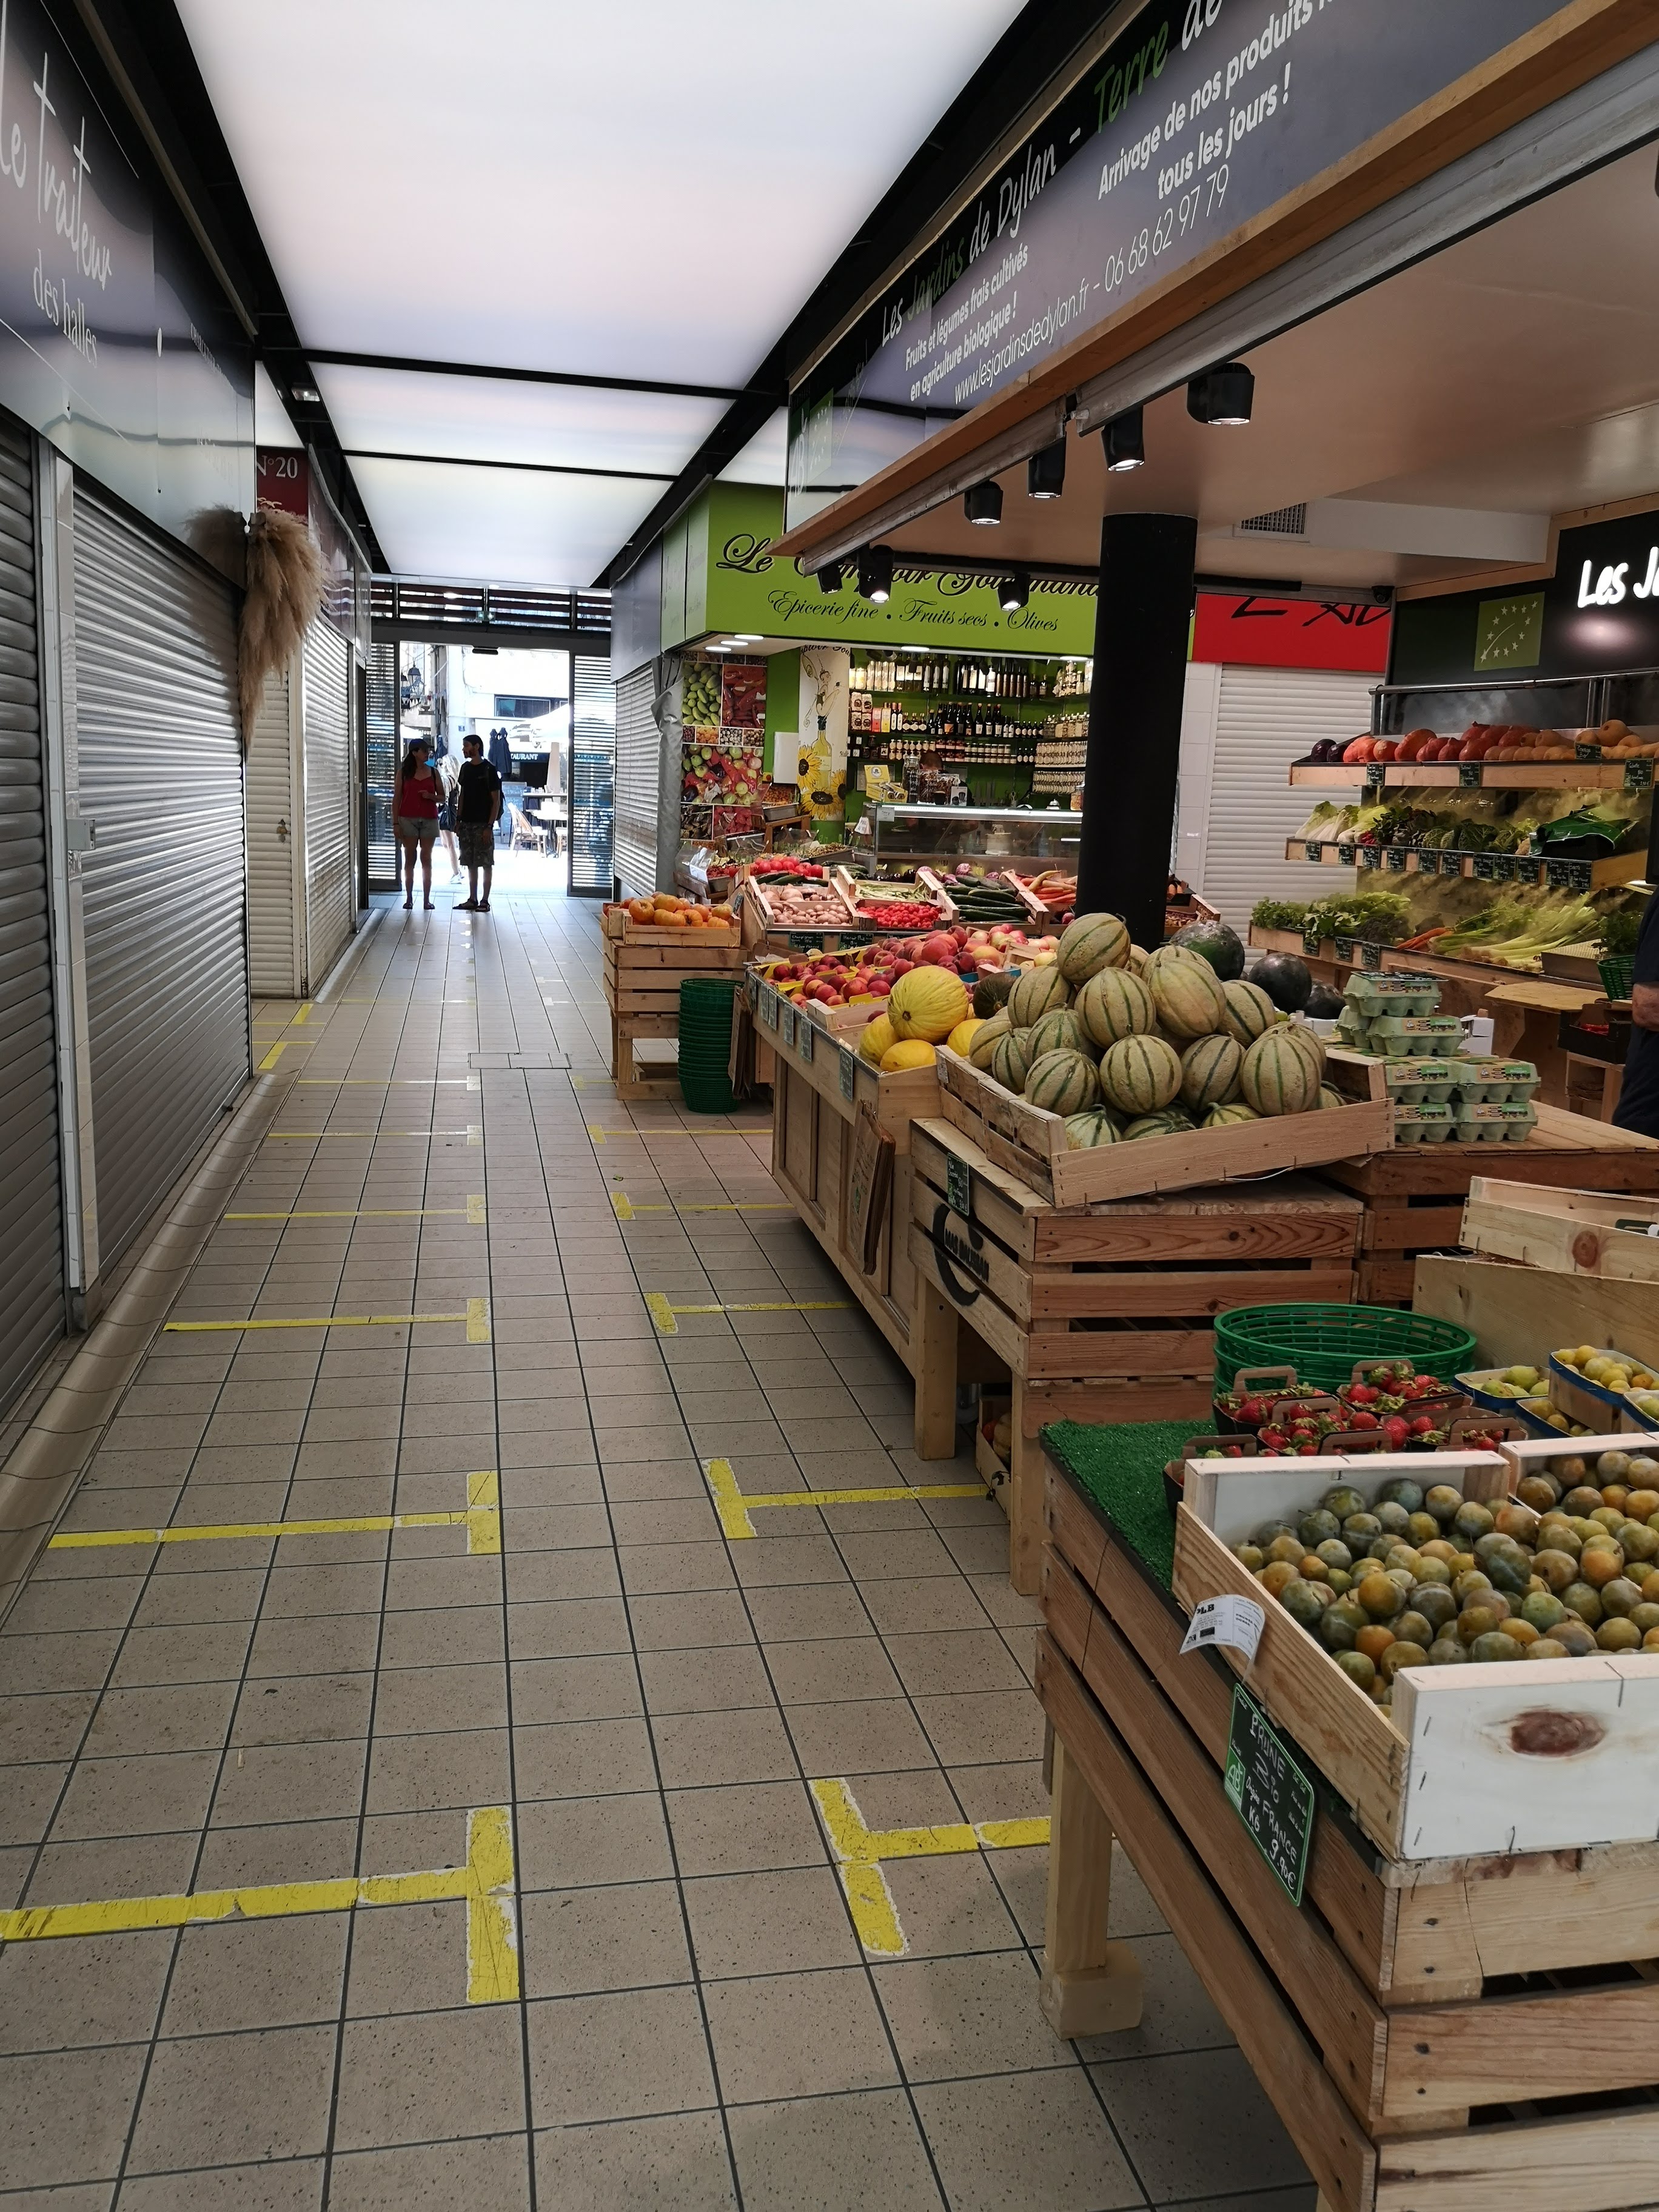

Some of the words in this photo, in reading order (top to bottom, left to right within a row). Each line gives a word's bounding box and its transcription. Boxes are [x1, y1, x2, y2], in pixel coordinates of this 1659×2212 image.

[1098, 126, 1160, 201] Arrivage
[1164, 101, 1185, 141] de
[1190, 70, 1221, 121] nos
[1225, 0, 1313, 99] produits
[1158, 150, 1193, 200] tous
[1198, 131, 1222, 170] les
[1225, 84, 1277, 159] jours
[882, 298, 903, 347] Les
[907, 237, 965, 321] Jardins
[970, 201, 990, 264] de
[997, 144, 1056, 238] Dylan
[1094, 21, 1168, 133] Terre
[33, 247, 59, 326] des
[62, 278, 98, 369] halles
[906, 337, 927, 372] Fruits
[928, 331, 936, 351] et
[937, 301, 969, 346] légumes
[970, 278, 990, 310] frais
[991, 243, 1029, 295] cultivés
[955, 278, 1089, 405] www.lesjardinsdedylan.fr
[1105, 248, 1124, 292] 06
[1128, 228, 1148, 275] 68
[1153, 207, 1173, 256] 62
[1179, 185, 1201, 236] 97
[1206, 164, 1230, 217] 79
[910, 378, 920, 402] en
[922, 346, 962, 396] agriculture
[964, 303, 1010, 359] biologique
[716, 534, 774, 574] Le
[1578, 559, 1629, 608] Les
[768, 590, 844, 622] Epicerie
[836, 598, 879, 625] fine
[899, 598, 956, 624] Fruits
[958, 612, 988, 626] secs
[1007, 606, 1059, 631] Olives
[1250, 1713, 1286, 1781] PRUNE
[1262, 1800, 1298, 1866] FRANCE
